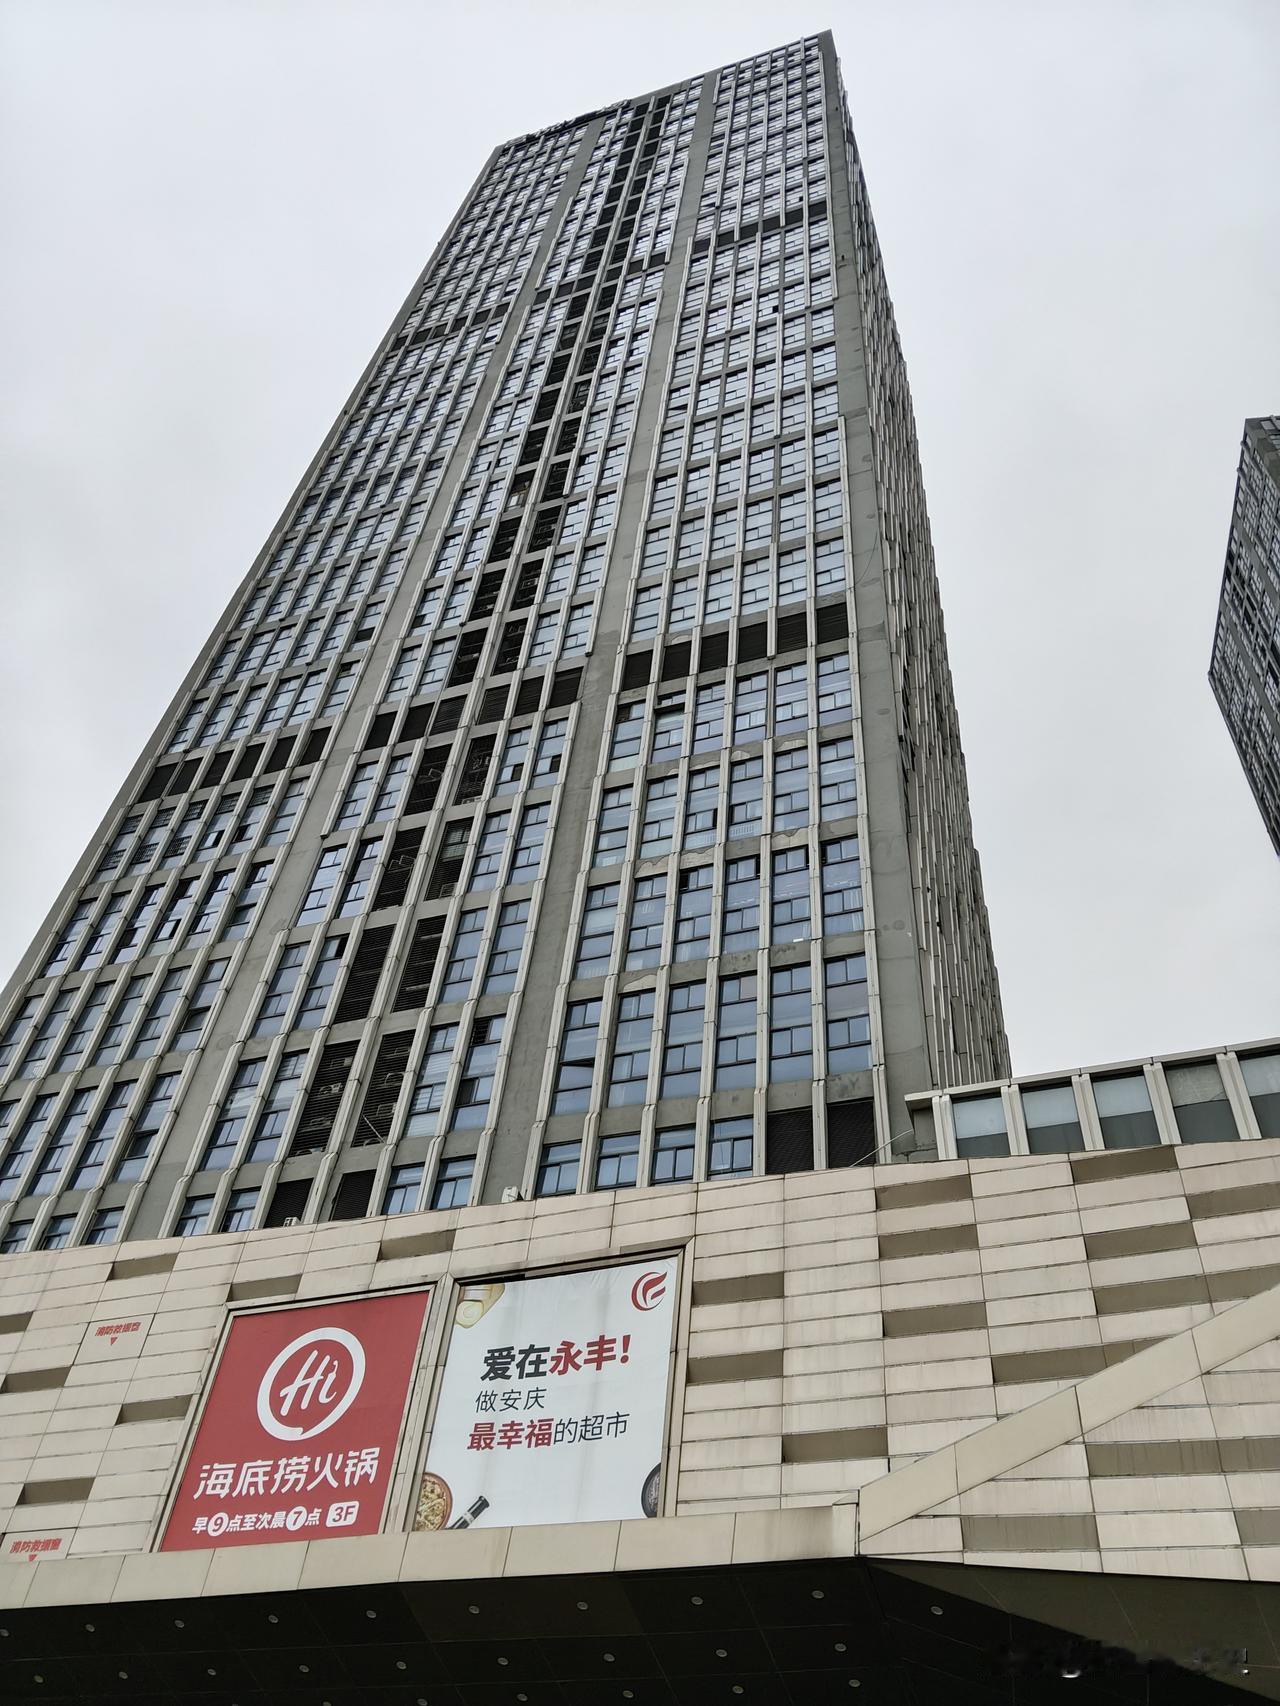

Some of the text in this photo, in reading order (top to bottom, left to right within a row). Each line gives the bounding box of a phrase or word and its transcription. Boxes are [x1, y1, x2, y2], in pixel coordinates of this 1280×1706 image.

[481, 1334, 631, 1381] 爱在永丰!
[279, 1350, 339, 1417] Hi
[475, 1386, 547, 1414] 做安庆
[466, 1411, 630, 1451] 最幸福的超市
[193, 1447, 380, 1500] 海底捞火锅
[332, 1505, 356, 1523] 3F
